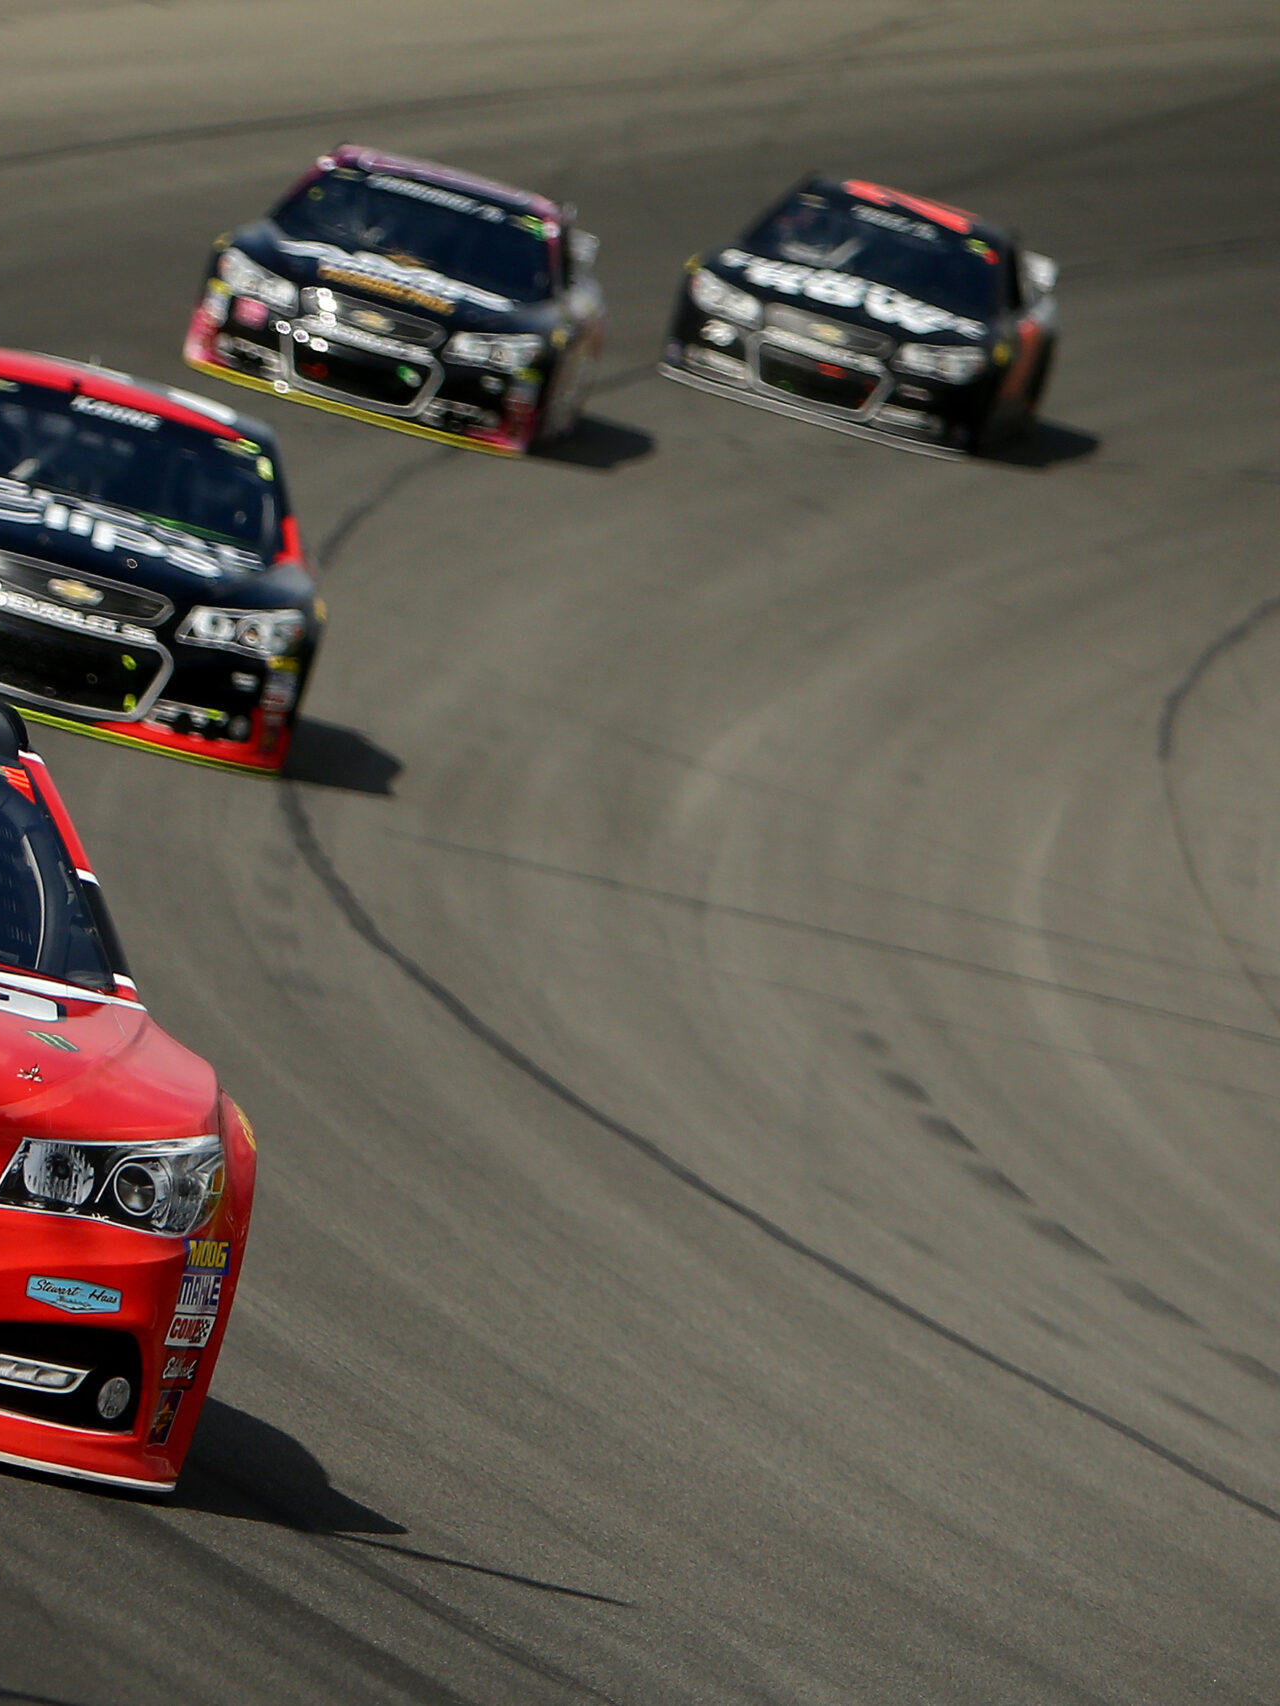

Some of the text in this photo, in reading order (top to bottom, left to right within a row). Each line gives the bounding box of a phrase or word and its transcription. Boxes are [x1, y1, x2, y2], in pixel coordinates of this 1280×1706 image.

[187, 1239, 229, 1269] MOOG
[31, 1278, 83, 1296] Stewart
[177, 1275, 221, 1306] MAHLE
